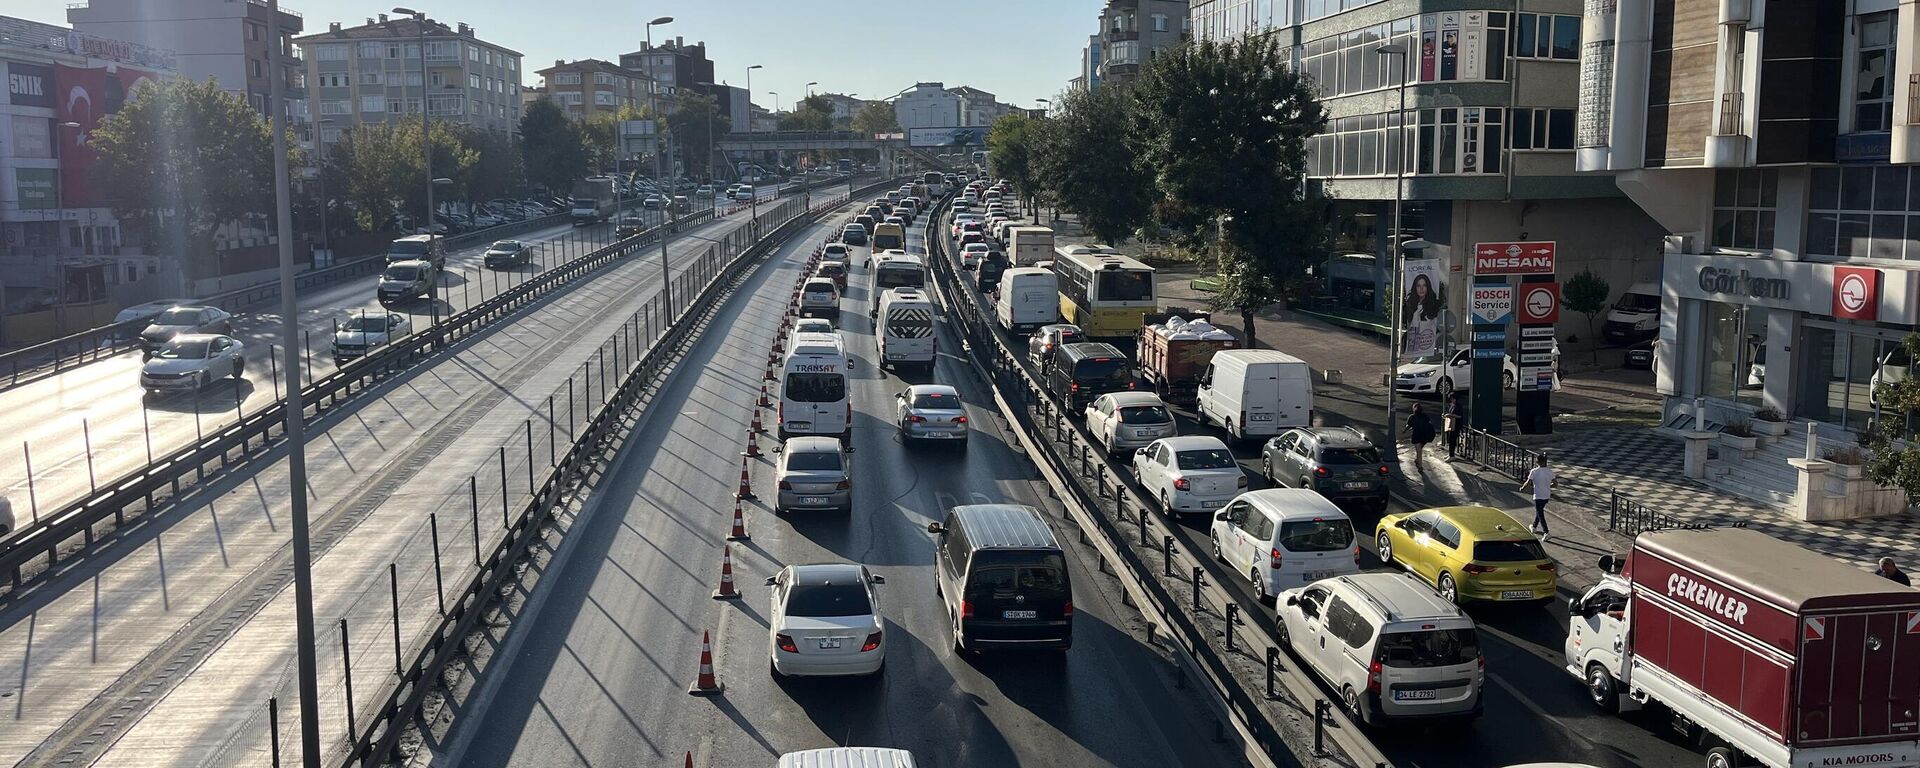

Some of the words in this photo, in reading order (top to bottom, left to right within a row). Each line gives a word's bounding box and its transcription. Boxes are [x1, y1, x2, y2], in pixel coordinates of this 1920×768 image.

[1699, 266, 1791, 300] Görkem
[1475, 290, 1510, 299] BOSCH
[1474, 301, 1510, 309] Service
[795, 364, 835, 372] TRANSAY
[1667, 572, 1748, 625] ÇEKENLER
[1823, 757, 1842, 766] KIA
[1846, 753, 1894, 765] MOTORS
